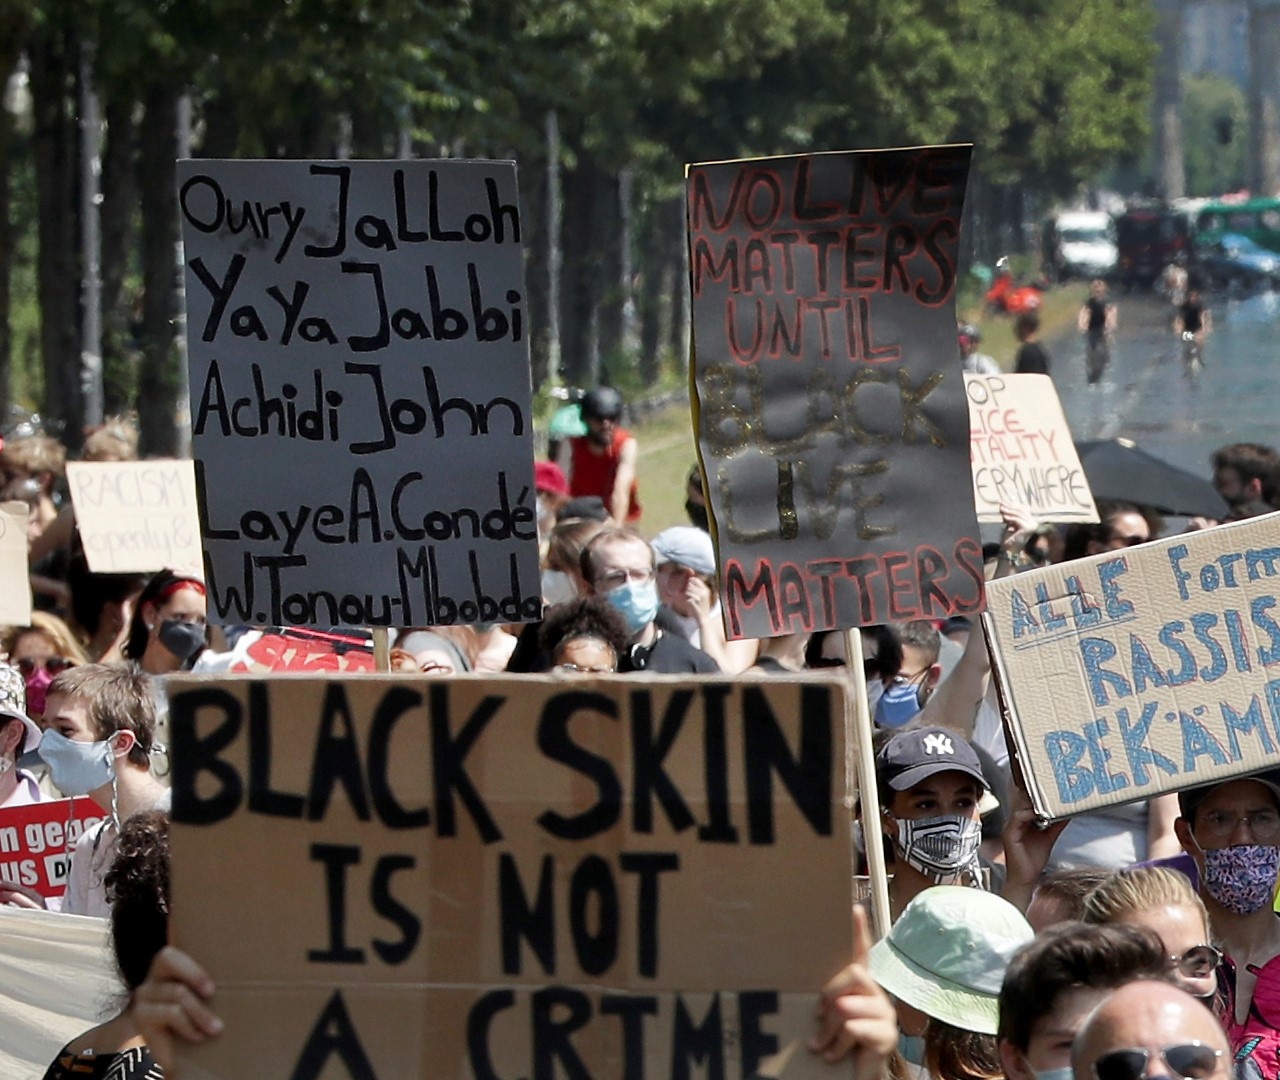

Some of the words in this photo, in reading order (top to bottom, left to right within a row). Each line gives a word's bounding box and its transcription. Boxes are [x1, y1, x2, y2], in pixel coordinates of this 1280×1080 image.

[180, 174, 305, 264] Oury
[692, 166, 781, 232] NO
[341, 262, 522, 352] Jabbi
[693, 217, 961, 310] MATTERS
[725, 295, 901, 366] UNTIL
[194, 359, 343, 442] Achidi
[345, 361, 524, 455] John
[704, 362, 944, 459] BLACK
[74, 469, 188, 509] RACISM
[725, 536, 988, 641] MATTERS
[1012, 556, 1137, 639] ALLE
[171, 682, 508, 845] BLACK
[536, 685, 836, 846] SKIN
[307, 843, 423, 966] IS
[497, 851, 681, 978] NOT
